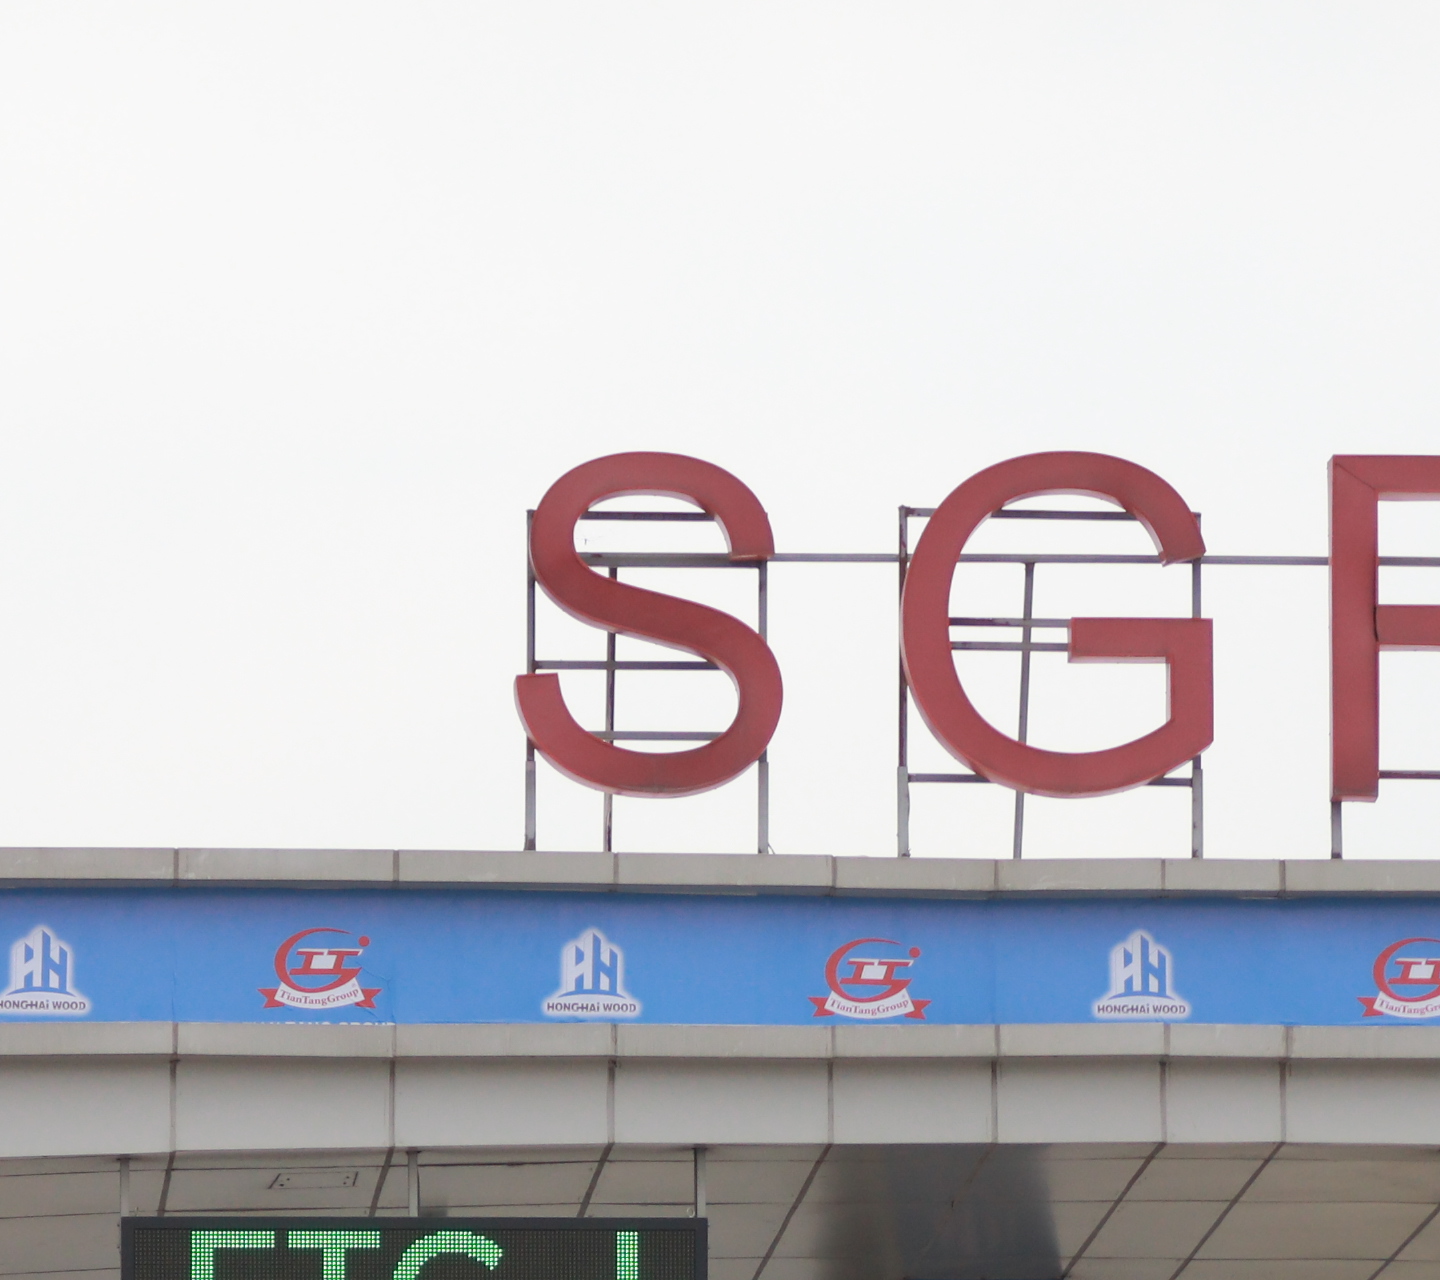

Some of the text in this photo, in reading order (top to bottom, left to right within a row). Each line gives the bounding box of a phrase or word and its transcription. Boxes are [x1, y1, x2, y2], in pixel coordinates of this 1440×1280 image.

[279, 985, 360, 1008] TianTangGroup
[53, 1000, 86, 1011] WOOD
[603, 1001, 636, 1012] WOOD
[829, 994, 911, 1018] TianTangGroup
[1153, 1004, 1187, 1015] WOOD
